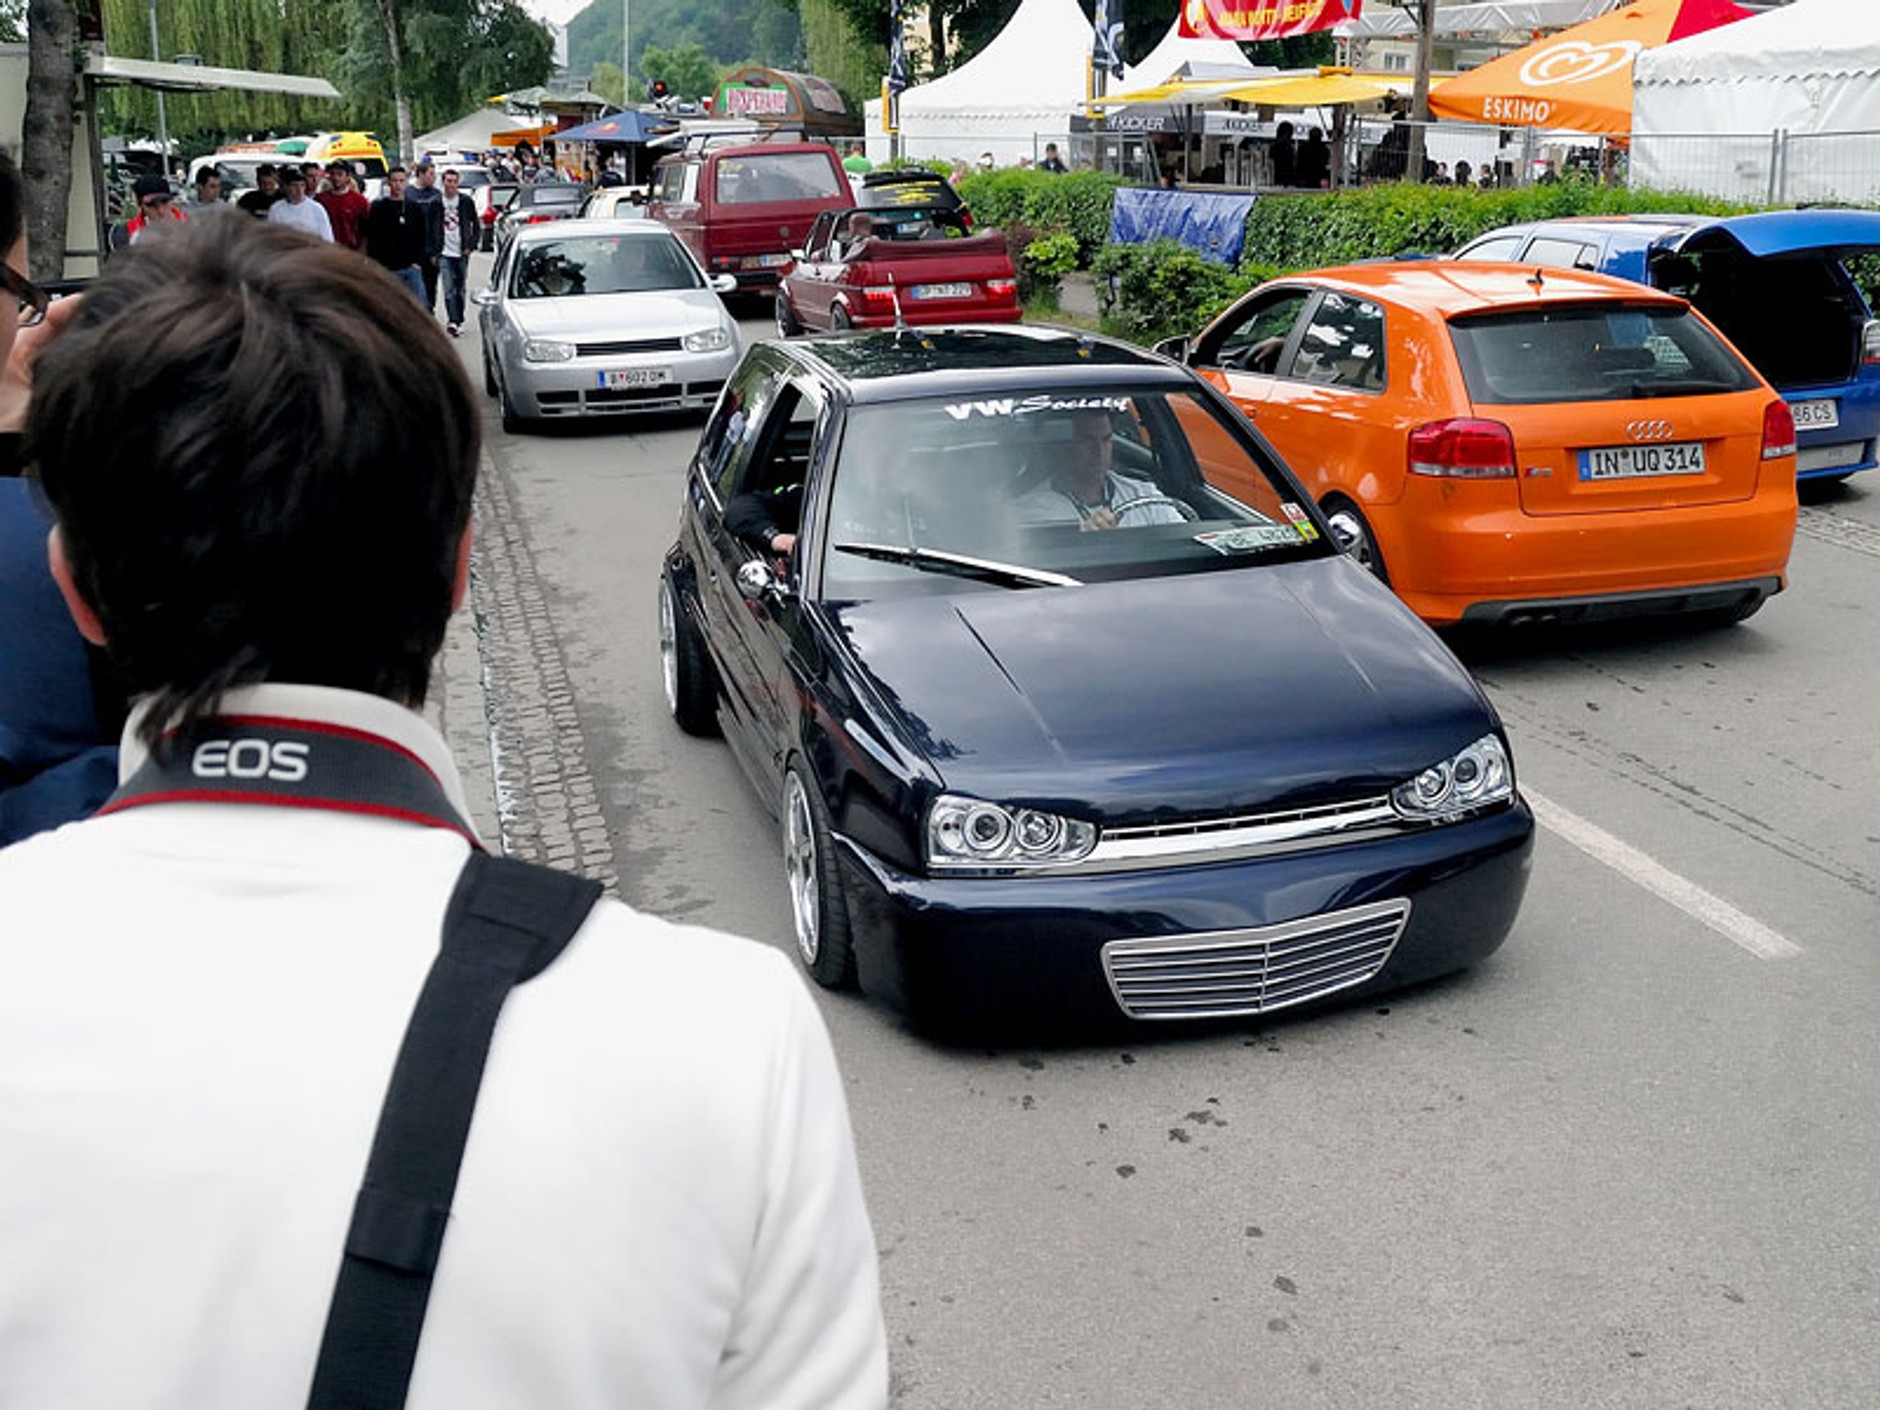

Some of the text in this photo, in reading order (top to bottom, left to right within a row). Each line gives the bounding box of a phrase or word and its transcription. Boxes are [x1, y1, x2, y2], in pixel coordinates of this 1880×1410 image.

[1483, 96, 1550, 122] ESKIMO
[1110, 115, 1164, 131] KICKER
[944, 394, 1129, 420] VW Society
[1594, 446, 1701, 476] IN UQ 314
[192, 738, 310, 782] EOS
